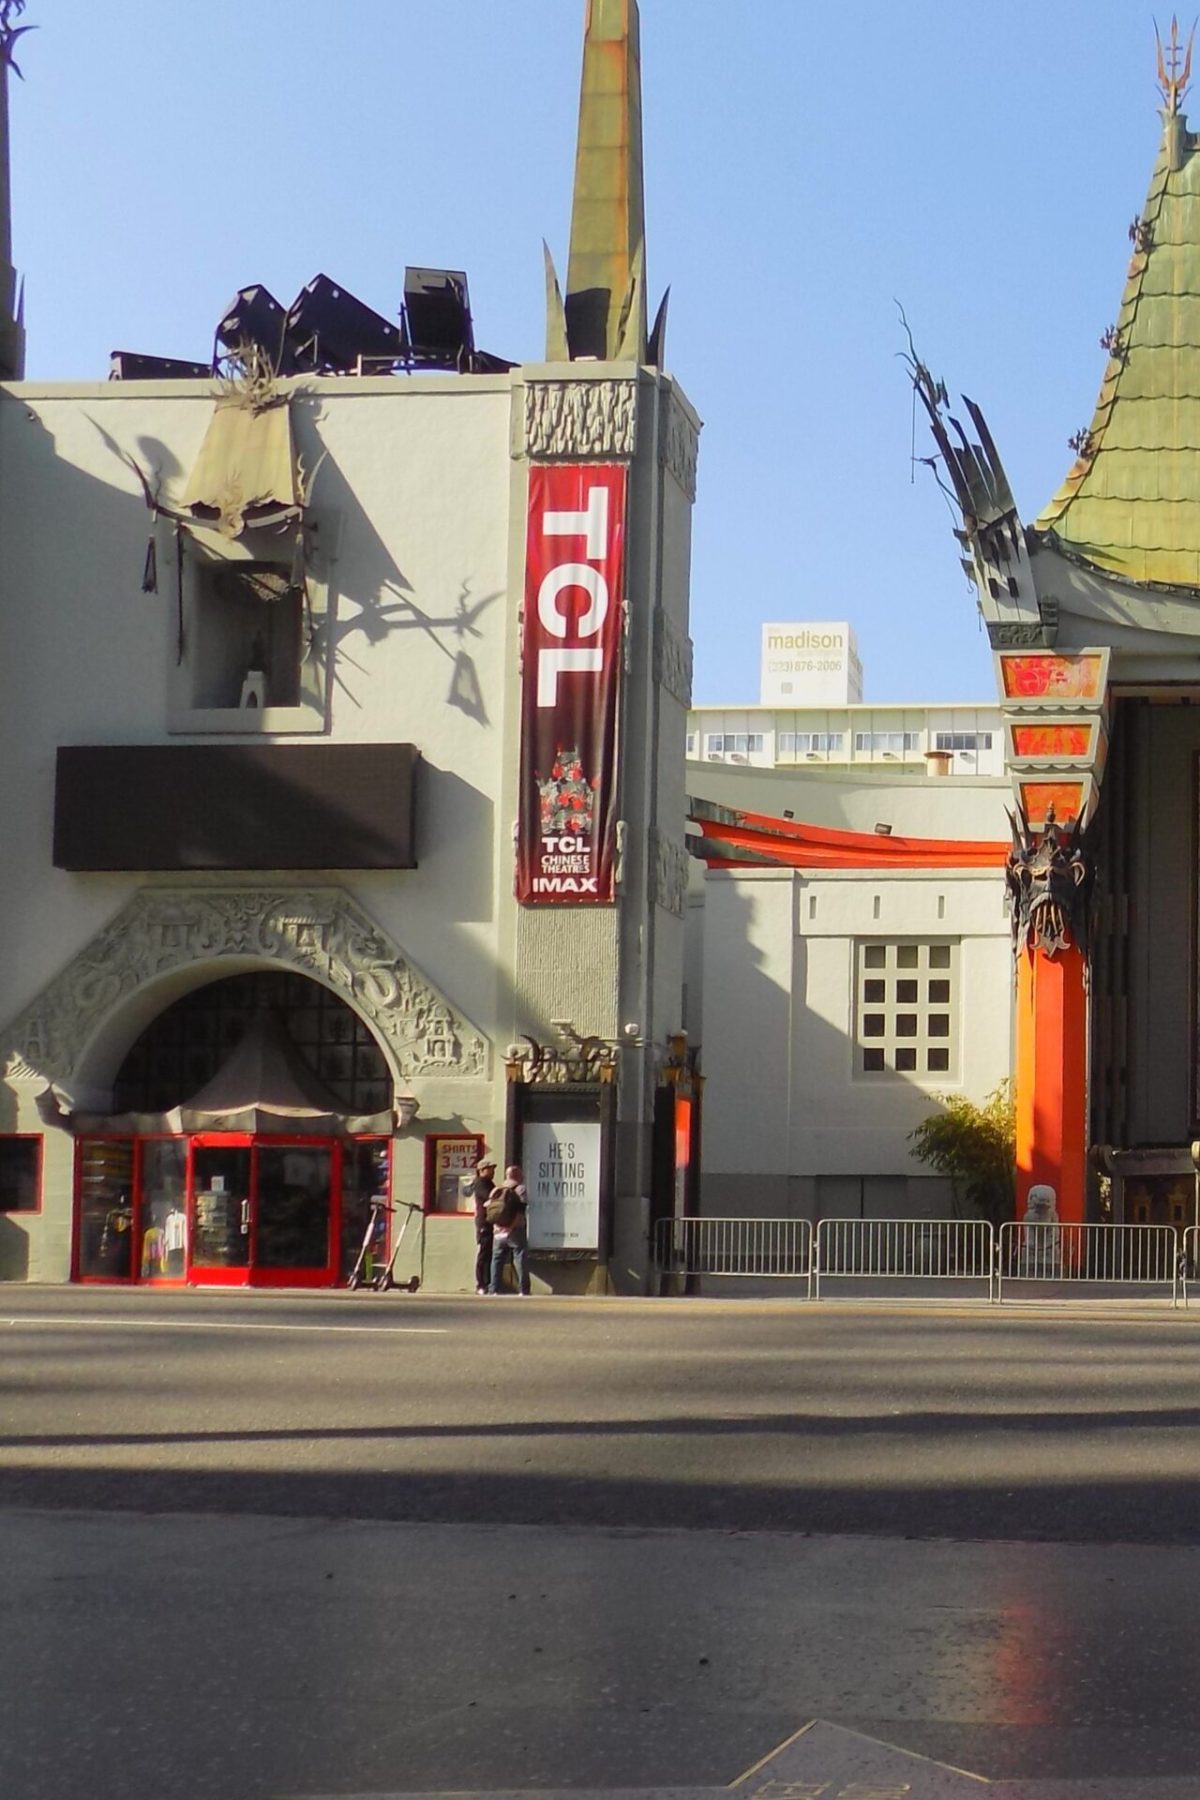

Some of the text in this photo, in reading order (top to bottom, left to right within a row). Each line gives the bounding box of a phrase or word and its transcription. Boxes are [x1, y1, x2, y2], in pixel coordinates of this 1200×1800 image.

[537, 486, 609, 707] TCL
[768, 630, 843, 649] madison
[541, 836, 591, 853] TCL
[541, 854, 590, 865] CHINESE
[541, 864, 590, 874] THEATRES
[532, 877, 598, 893] IMAX
[549, 1142, 575, 1159] HE'S
[538, 1162, 585, 1179] SITTING
[537, 1181, 585, 1198] IN YOUR
